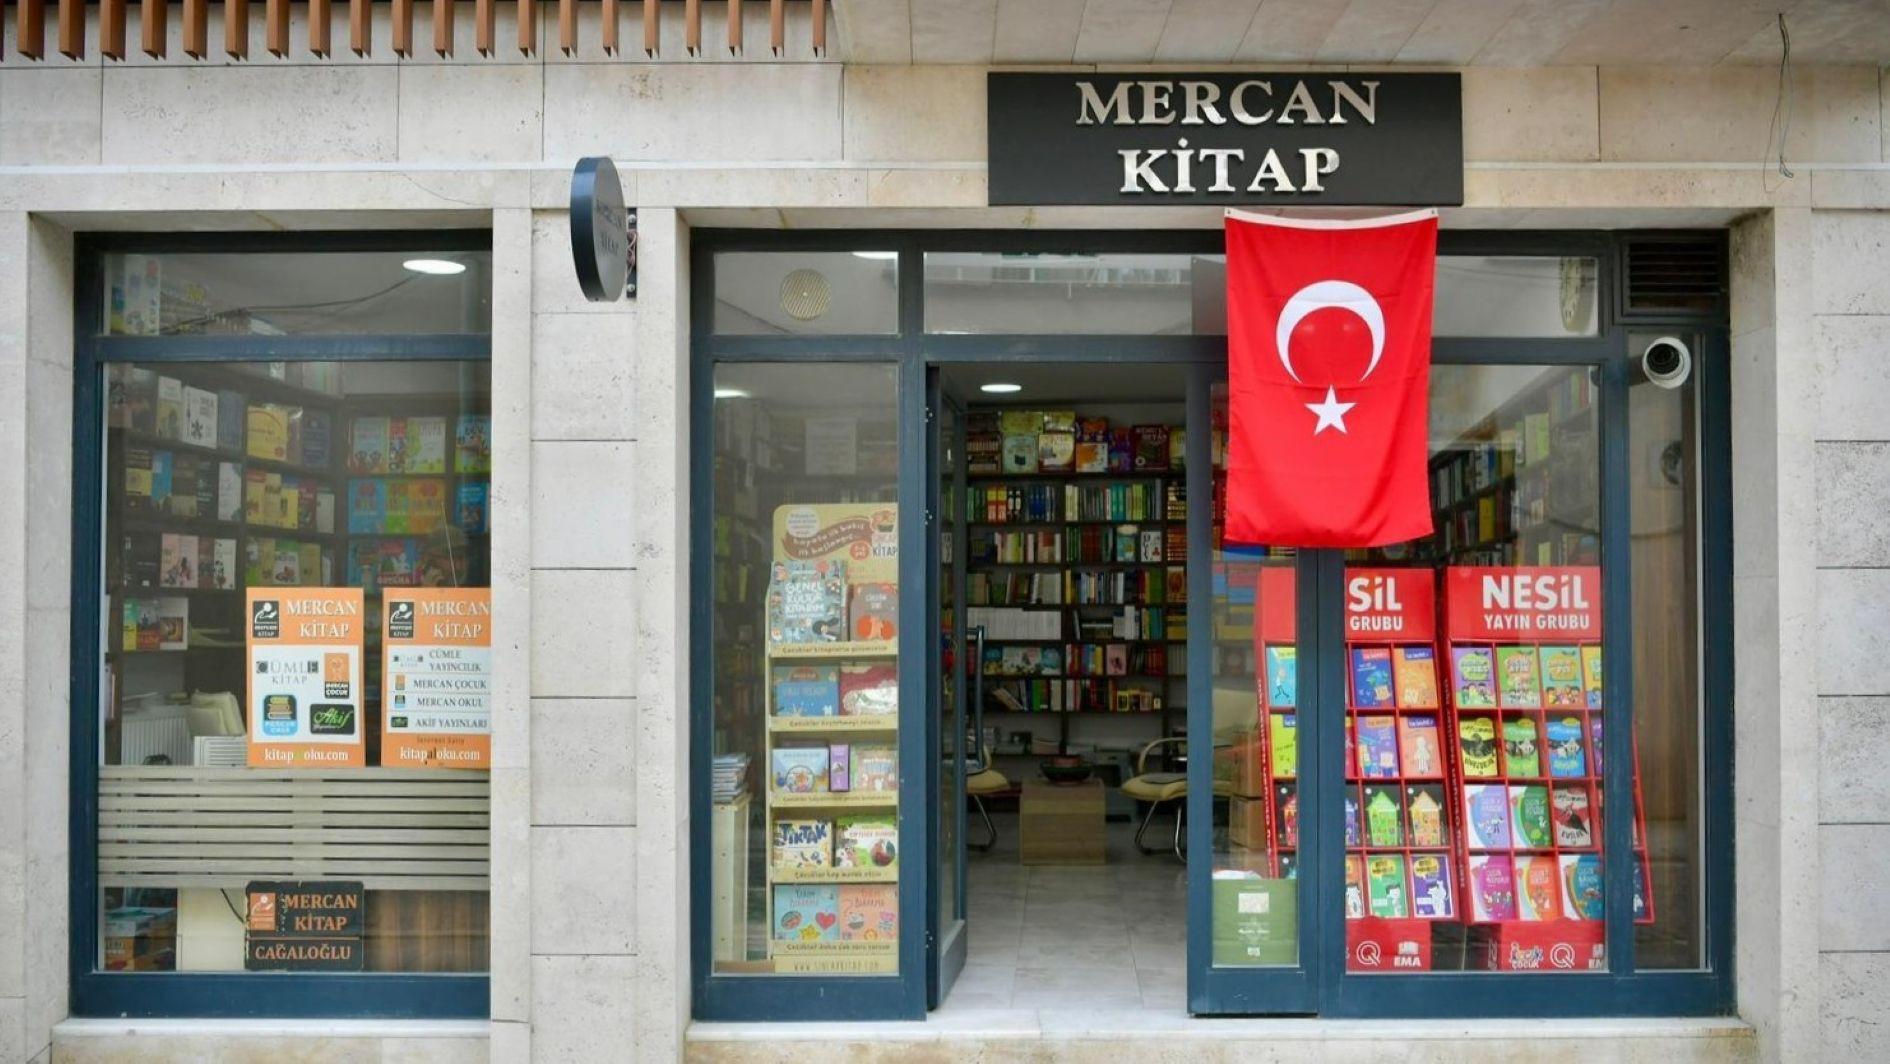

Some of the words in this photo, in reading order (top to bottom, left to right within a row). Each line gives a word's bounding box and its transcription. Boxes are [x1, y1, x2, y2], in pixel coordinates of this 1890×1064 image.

[1075, 80, 1381, 126] MERCAN
[1117, 137, 1341, 194] KİTAP
[1348, 576, 1403, 612] SİL
[1482, 574, 1590, 611] NESİL
[287, 599, 358, 616] MERCAN
[422, 601, 489, 616] MERCAN
[300, 619, 349, 637] KİTAP
[434, 619, 482, 638] KİTAP
[1350, 616, 1403, 631] GRUBU
[1484, 614, 1530, 630] YAYIN
[1536, 613, 1590, 629] GRUBU
[429, 649, 462, 659] CÜMLE
[430, 662, 481, 672] YAYINCILIK
[414, 680, 452, 689] MERCAN
[455, 680, 487, 690] ÇOCUK
[417, 697, 456, 707] MERCAN
[458, 697, 482, 707] OKUL
[415, 717, 436, 727] AKİF
[439, 718, 488, 728] YAYINLARI
[284, 894, 357, 909] MERCAN
[294, 912, 348, 931] KİTAP
[255, 943, 351, 960] CAĞALOĞLU
[1394, 957, 1422, 967] EMA
